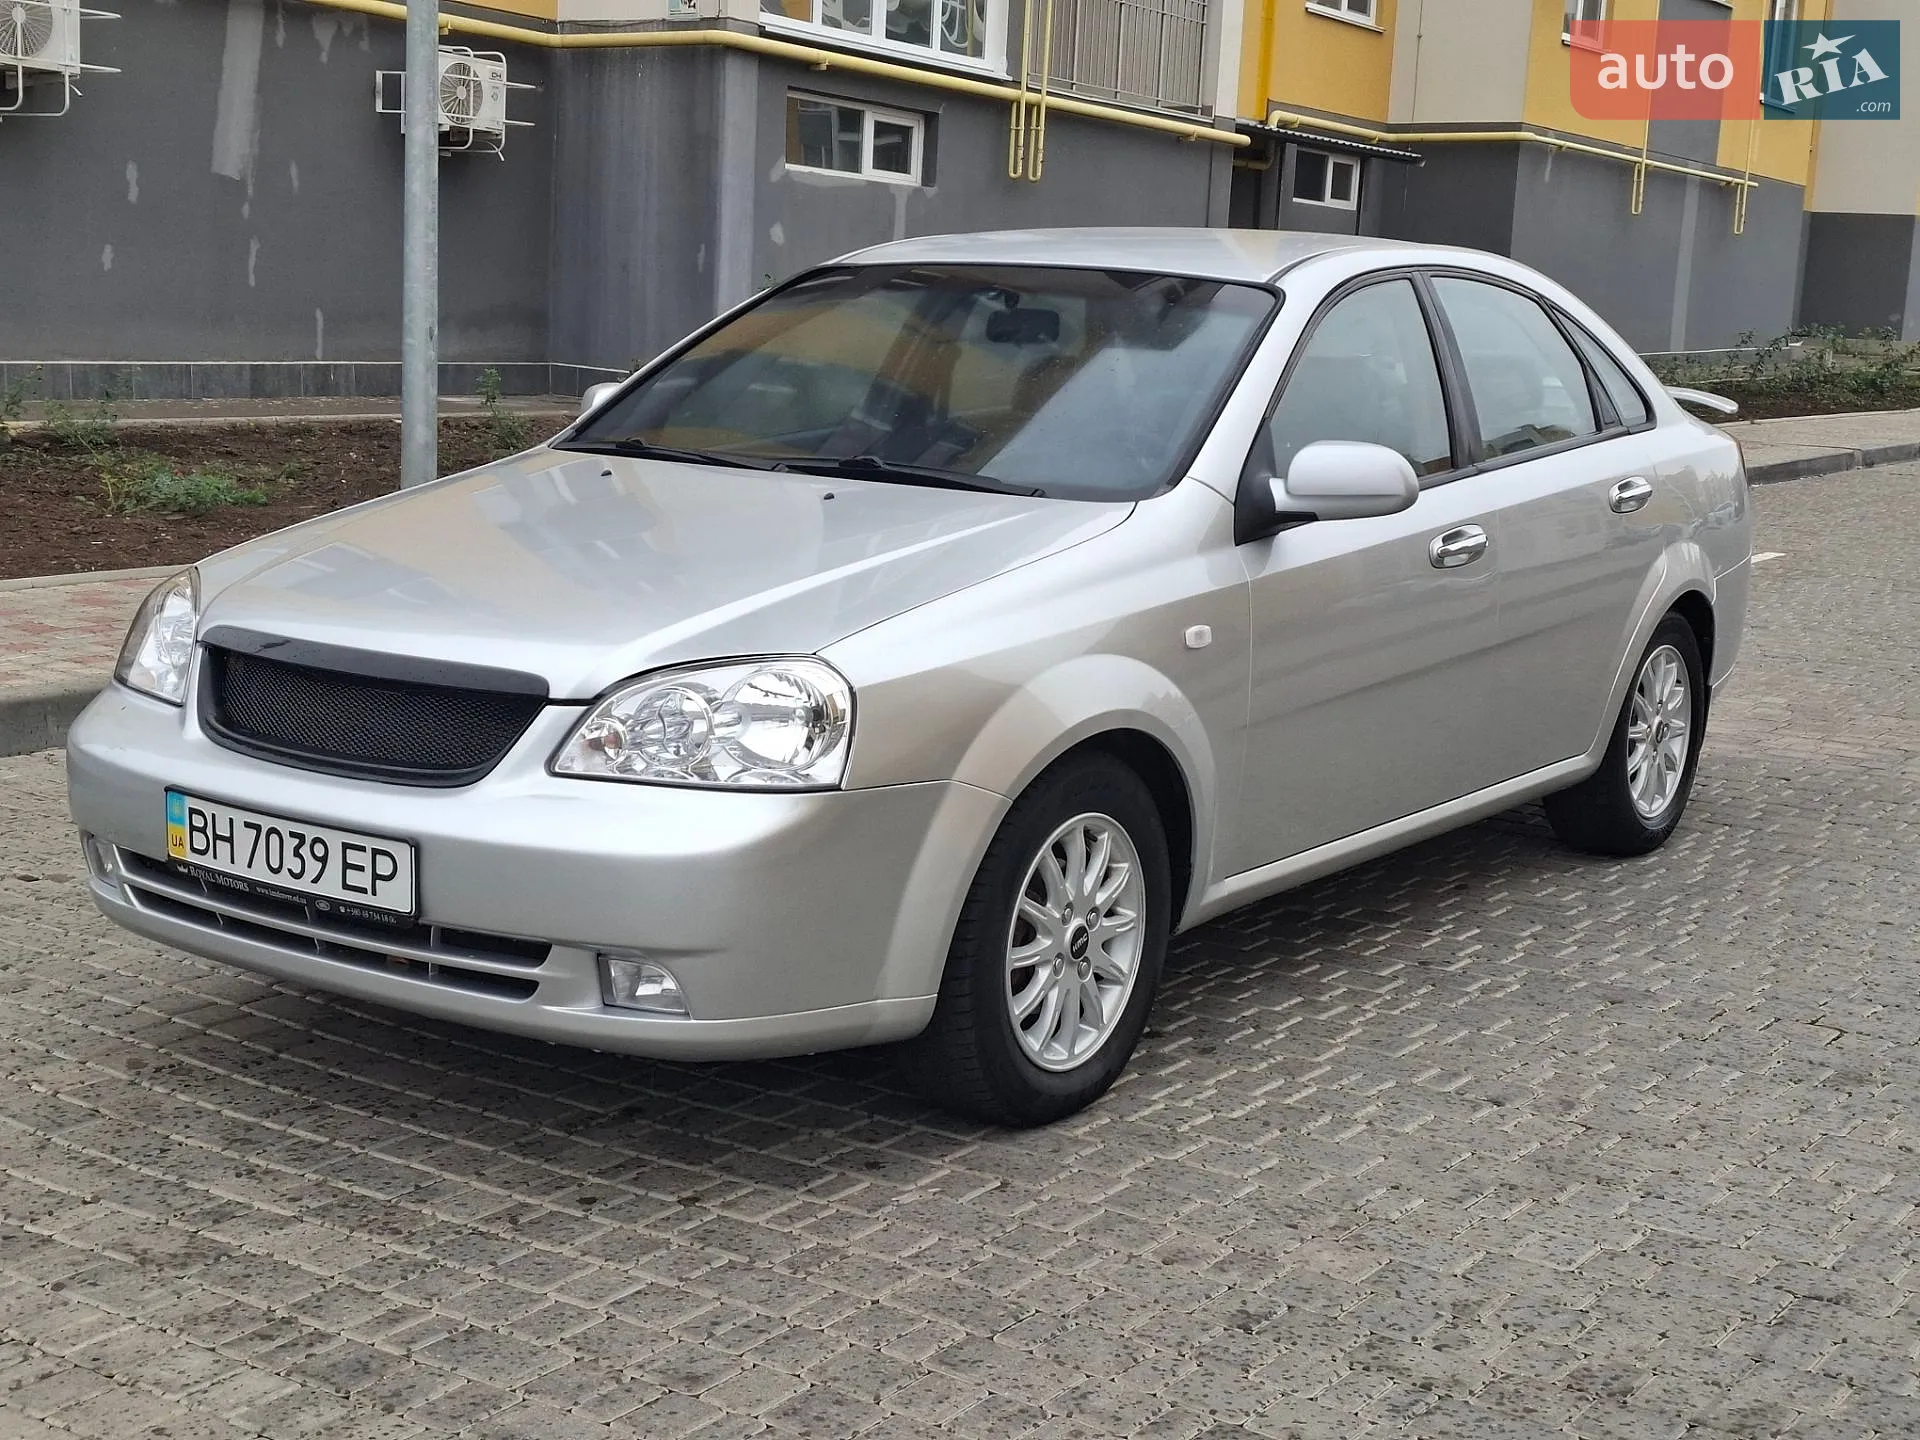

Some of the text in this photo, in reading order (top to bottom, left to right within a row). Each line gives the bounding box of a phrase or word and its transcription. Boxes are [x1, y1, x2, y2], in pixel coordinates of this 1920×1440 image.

[171, 834, 185, 850] UA
[188, 806, 398, 897] BH 7039 EP
[189, 865, 250, 892] ROYAL MOTORS
